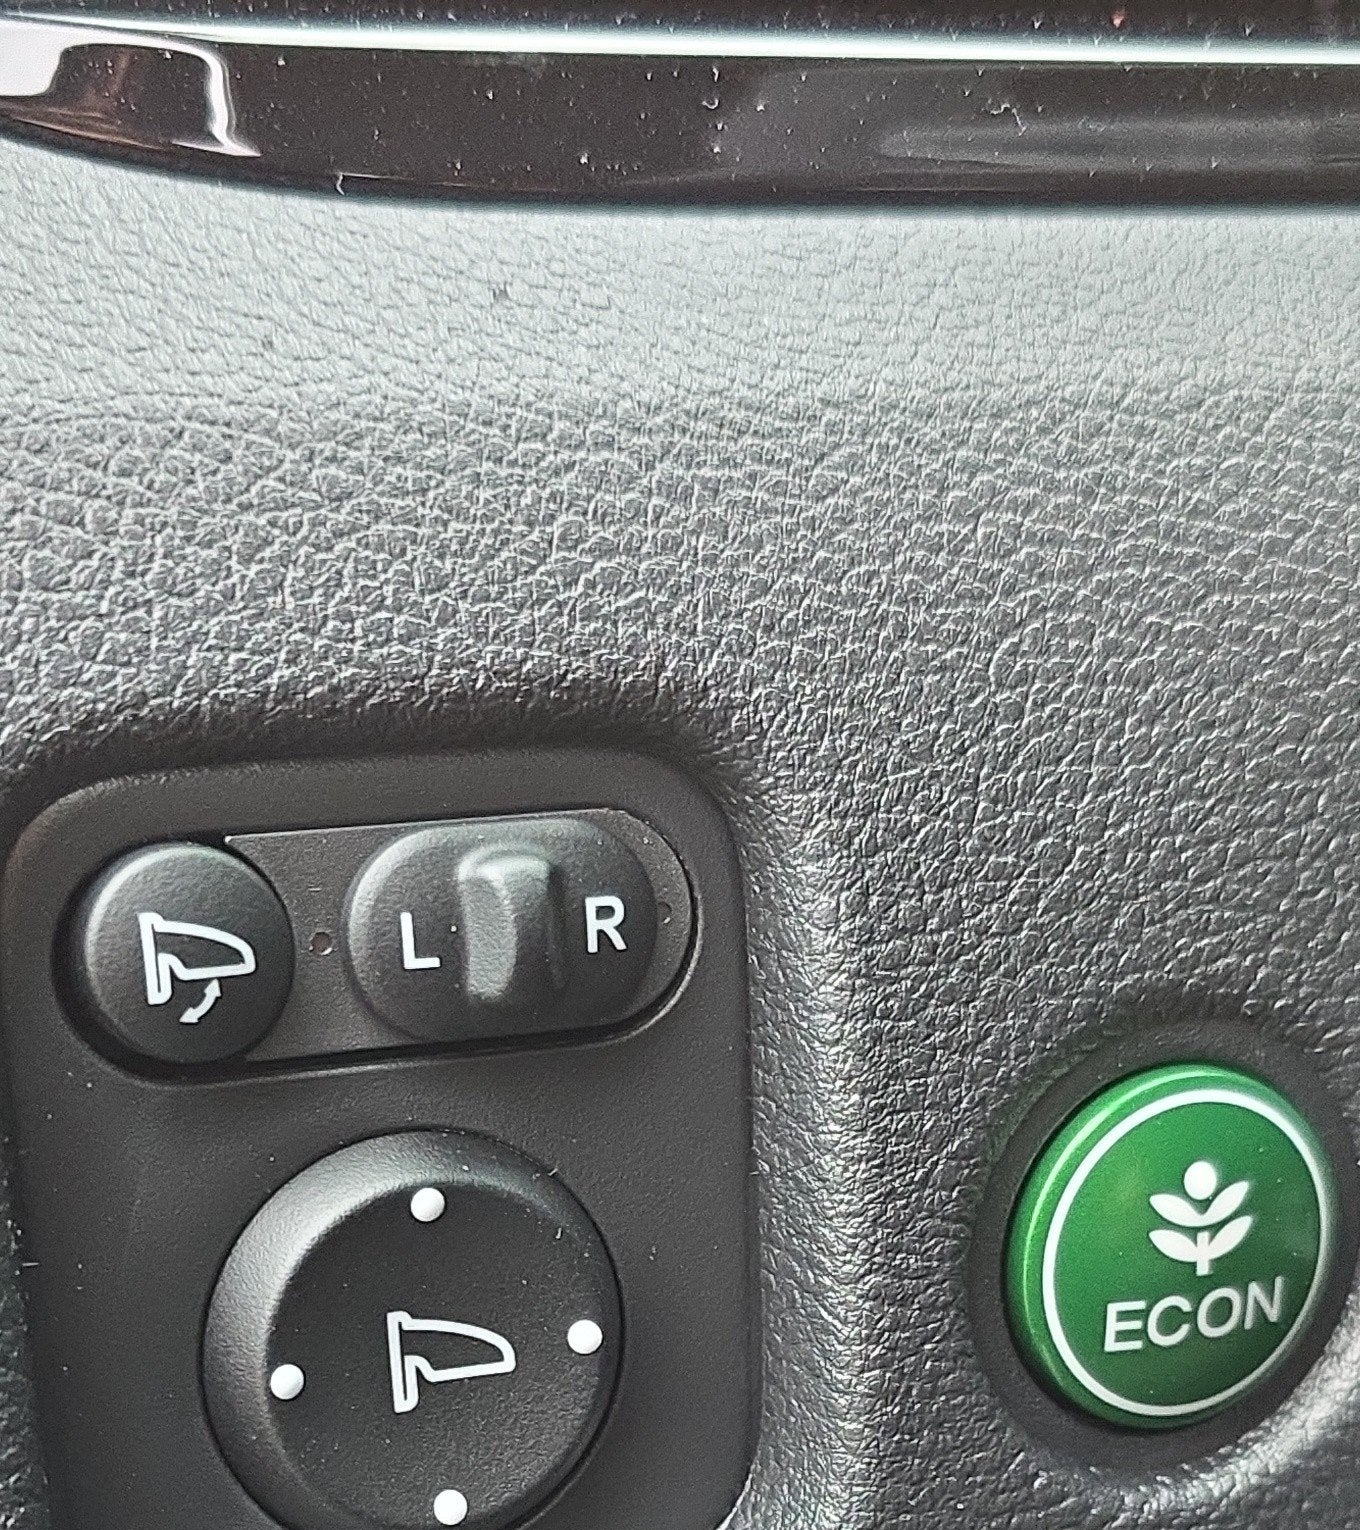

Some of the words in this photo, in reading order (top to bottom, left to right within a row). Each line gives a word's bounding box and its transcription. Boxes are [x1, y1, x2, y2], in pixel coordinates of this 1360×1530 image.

[399, 911, 441, 970] L
[584, 894, 628, 954] R
[1103, 1275, 1285, 1353] ECON
